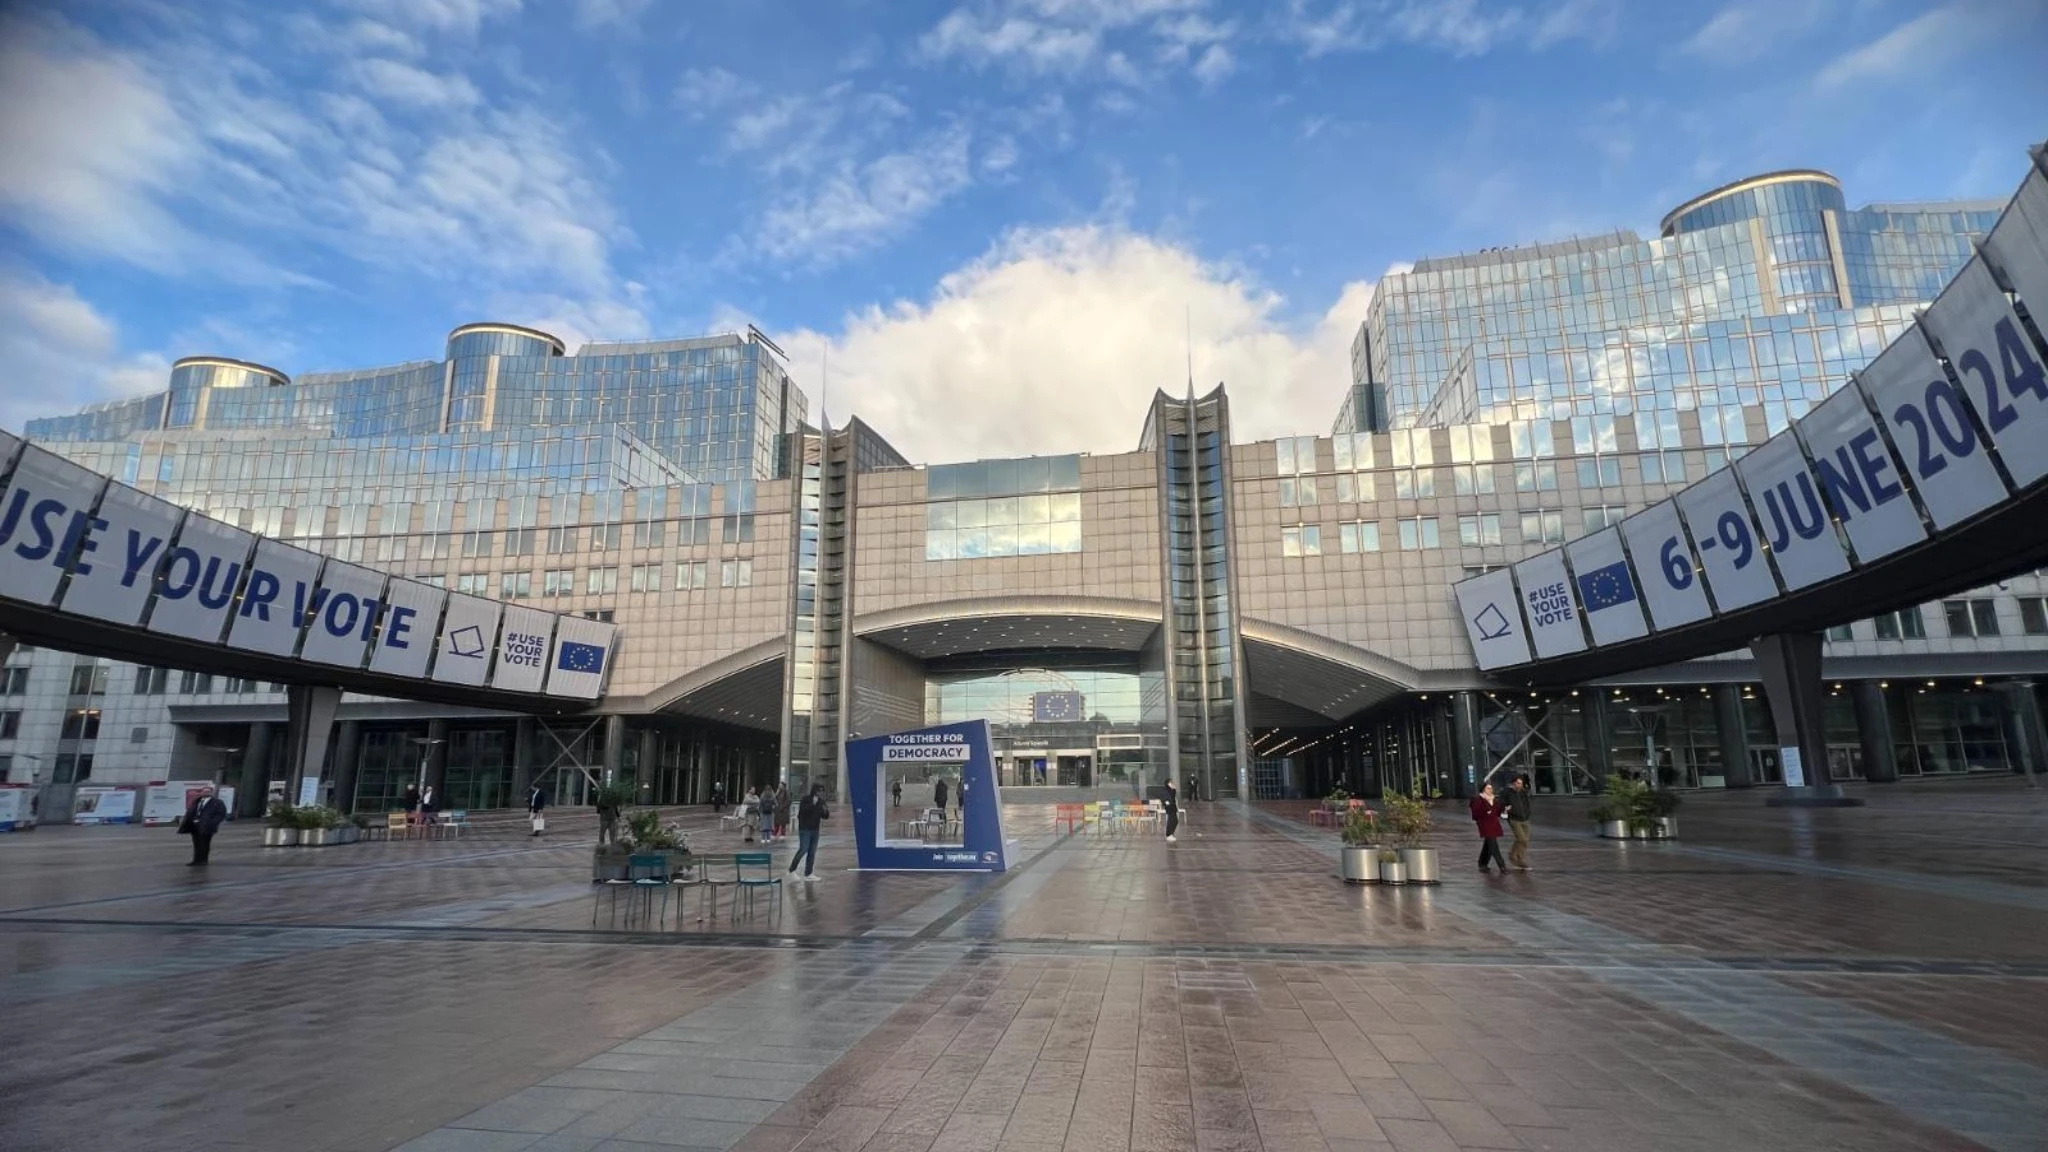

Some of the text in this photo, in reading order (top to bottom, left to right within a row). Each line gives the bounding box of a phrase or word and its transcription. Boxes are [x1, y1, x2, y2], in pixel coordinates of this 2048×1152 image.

[1660, 314, 2048, 591] 6-9 JUNE 2024
[120, 529, 280, 622] YOUR
[292, 580, 417, 649] VOTE
[1529, 582, 1566, 603] #USE
[1531, 595, 1569, 614] YOUR
[1534, 608, 1573, 627] VOTE
[507, 632, 544, 646] #USE
[507, 642, 542, 657] YOUR
[504, 653, 541, 667] VOTE
[889, 733, 963, 744] TOGETHER FOR
[889, 747, 963, 758] DEMOCRACY
